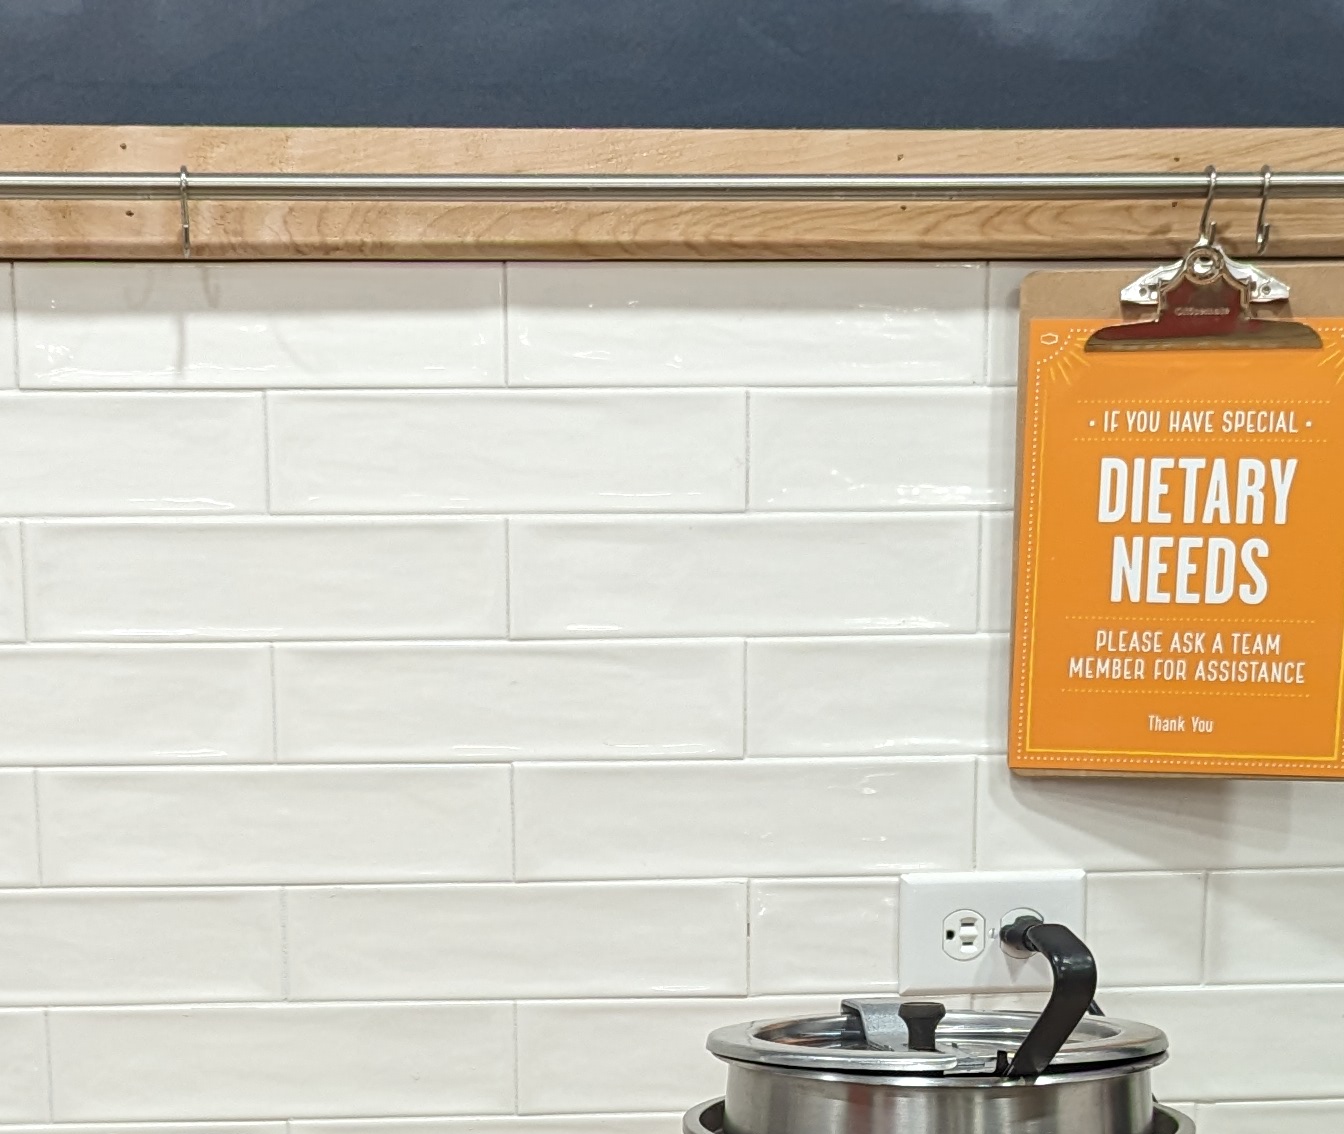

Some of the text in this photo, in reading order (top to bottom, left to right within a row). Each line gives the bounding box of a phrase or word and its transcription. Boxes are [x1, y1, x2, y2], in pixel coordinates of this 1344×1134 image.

[1103, 410, 1299, 433] IF YOU HAVE SPECIAL
[1098, 457, 1299, 525] DIETARY
[1110, 536, 1269, 605] NEEDS
[1095, 630, 1281, 656] PLEASE ASK A TEAM
[1068, 657, 1306, 684] MEMBER FOR ASSISTANCE
[1148, 714, 1214, 733] Thank You
